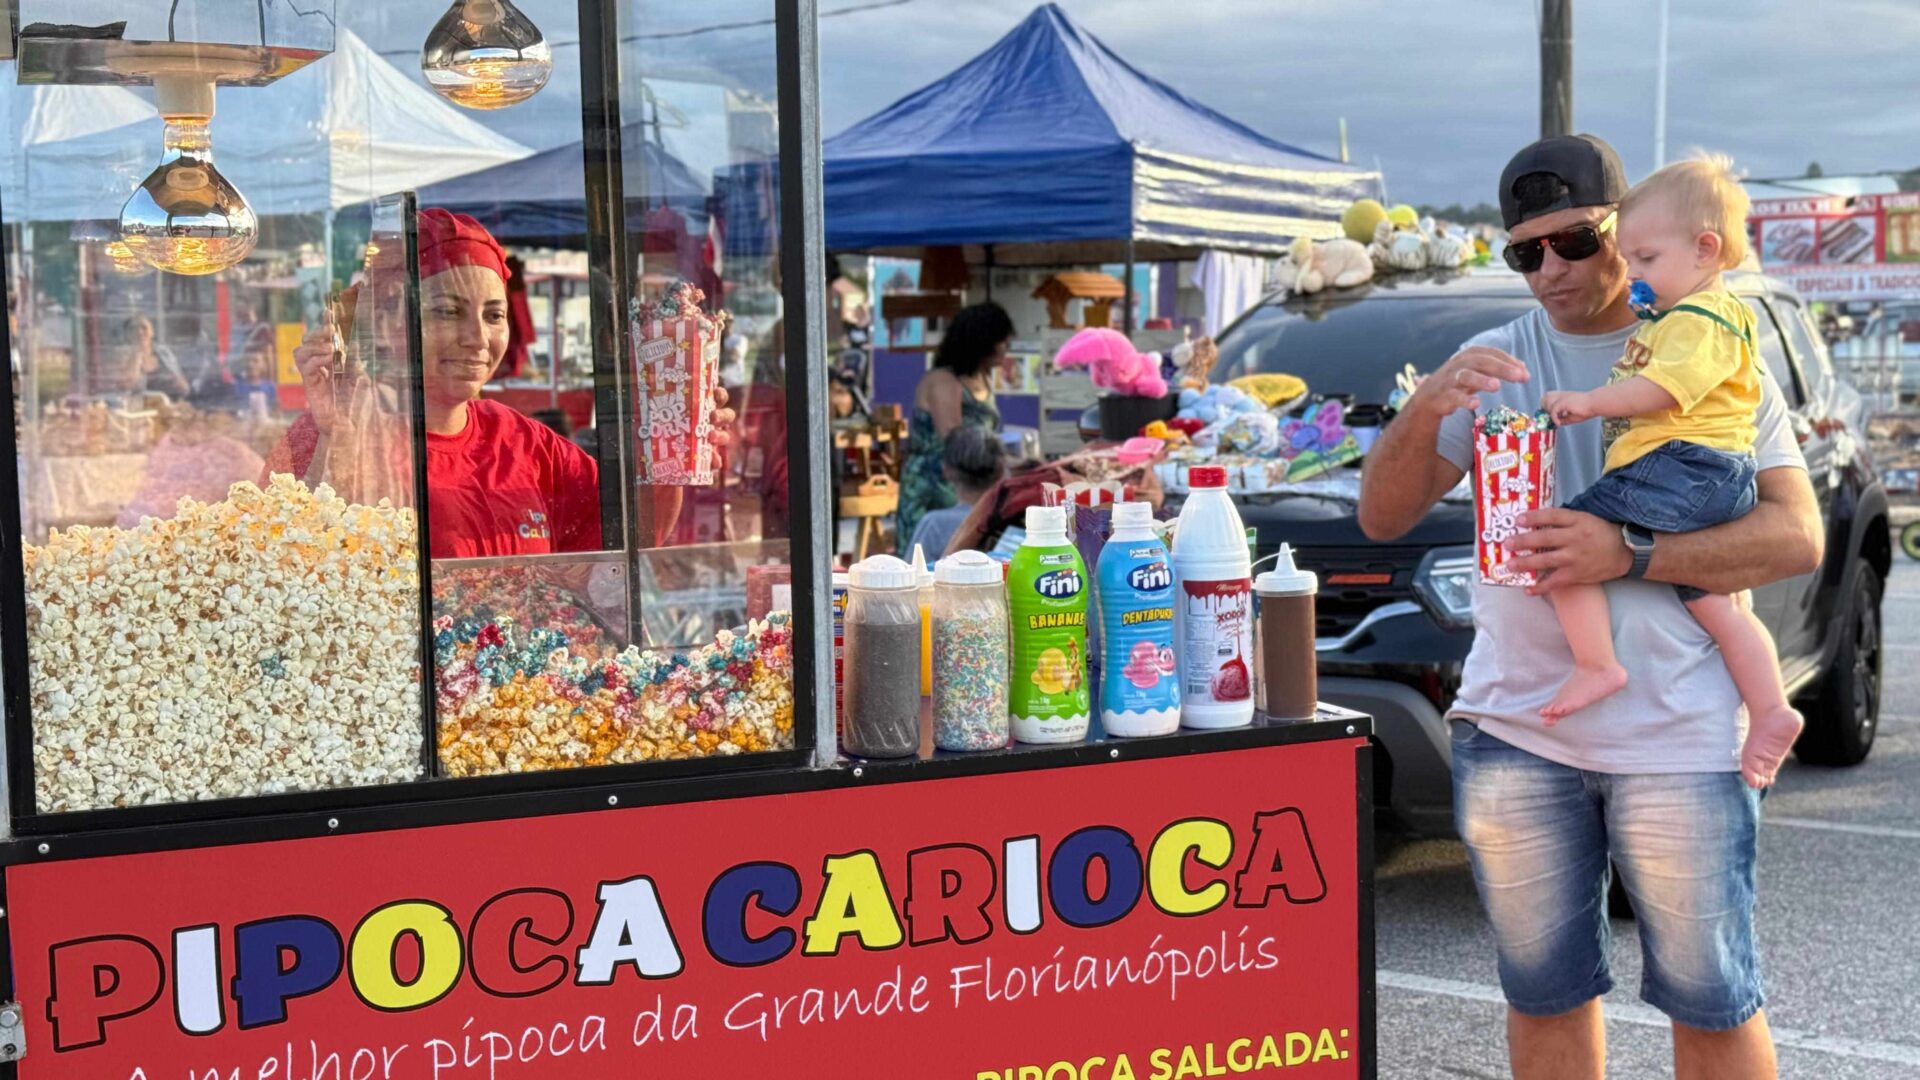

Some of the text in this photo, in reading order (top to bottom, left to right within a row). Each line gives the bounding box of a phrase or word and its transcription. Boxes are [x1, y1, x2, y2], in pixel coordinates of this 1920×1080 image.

[649, 402, 687, 423] POP
[1039, 569, 1080, 596] Fini
[1132, 564, 1171, 590] Fini
[46, 807, 1328, 1052] PIPOCA CARIOCA
[423, 1015, 607, 1080] pipoca
[633, 993, 699, 1047] da
[722, 963, 930, 1042] Grande
[948, 924, 1280, 1006] Florianópolis
[1149, 1027, 1350, 1080] SALGADA:
